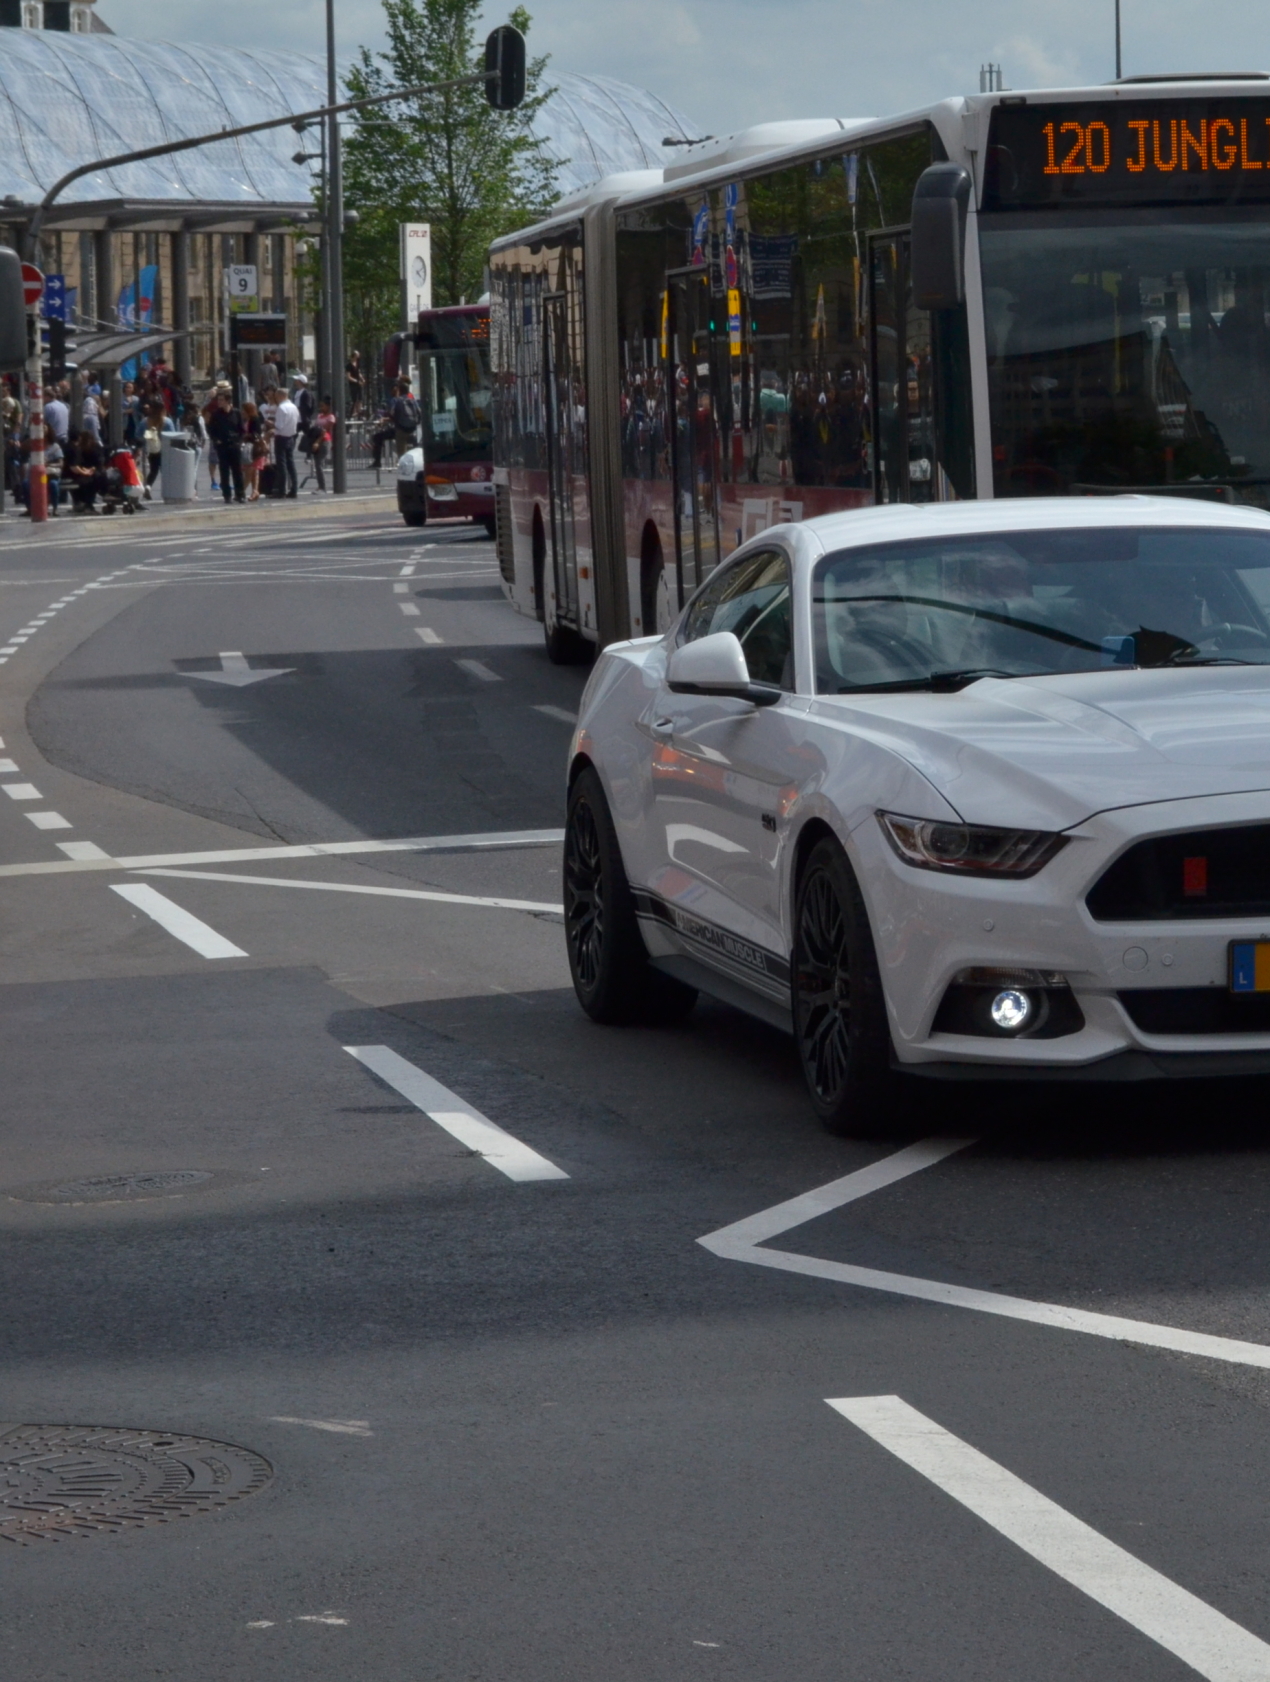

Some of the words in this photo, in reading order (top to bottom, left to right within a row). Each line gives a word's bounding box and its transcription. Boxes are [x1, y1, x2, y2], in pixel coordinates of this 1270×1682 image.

[1043, 121, 1110, 174] 120
[238, 278, 248, 292] 9
[1239, 972, 1247, 984] L
